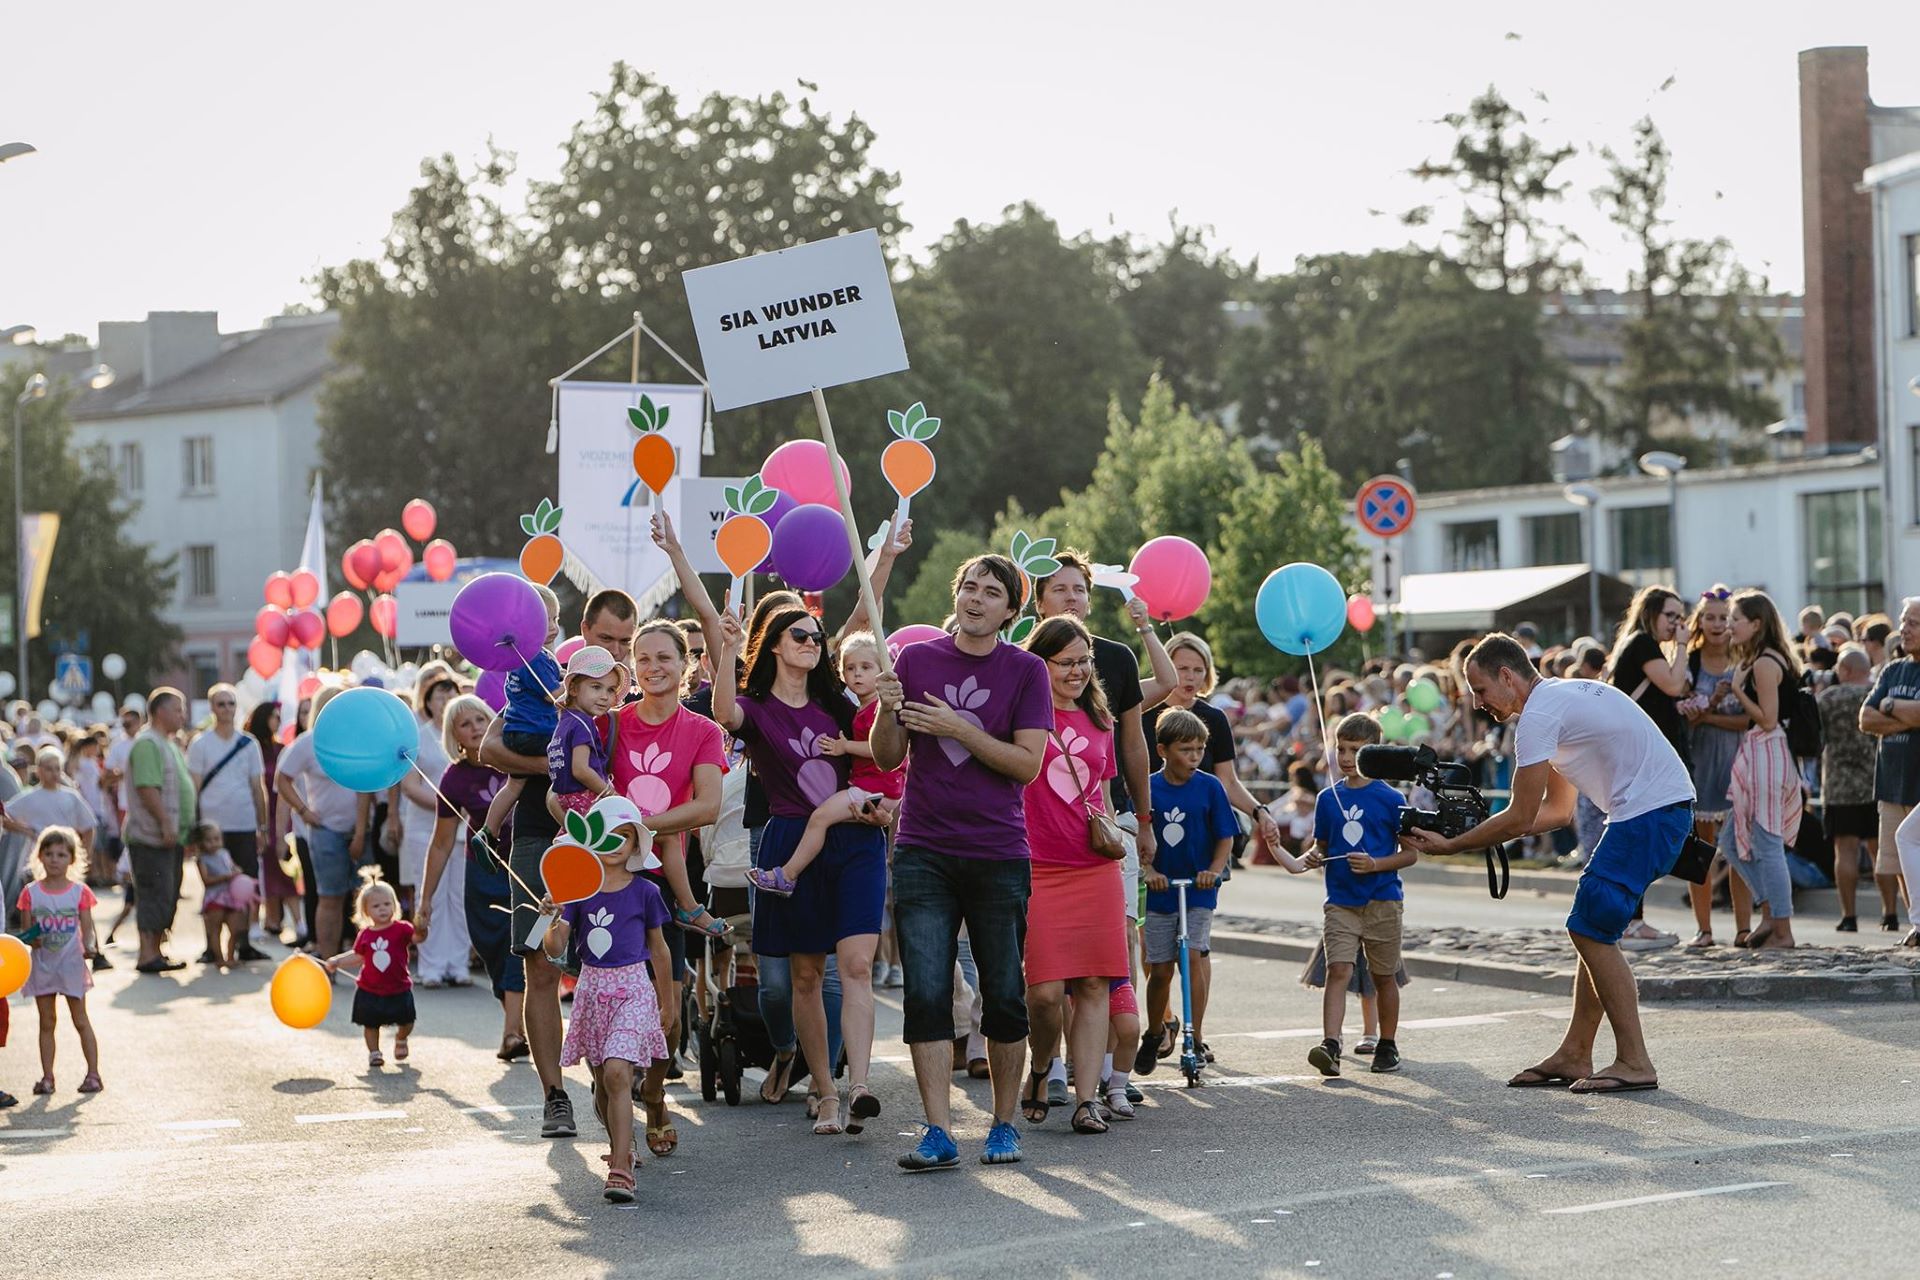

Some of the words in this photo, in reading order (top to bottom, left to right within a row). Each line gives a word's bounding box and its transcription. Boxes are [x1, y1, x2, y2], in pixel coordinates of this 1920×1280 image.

[719, 309, 758, 332] SIA
[761, 285, 863, 322] WUNDER
[758, 318, 837, 350] LATVIA
